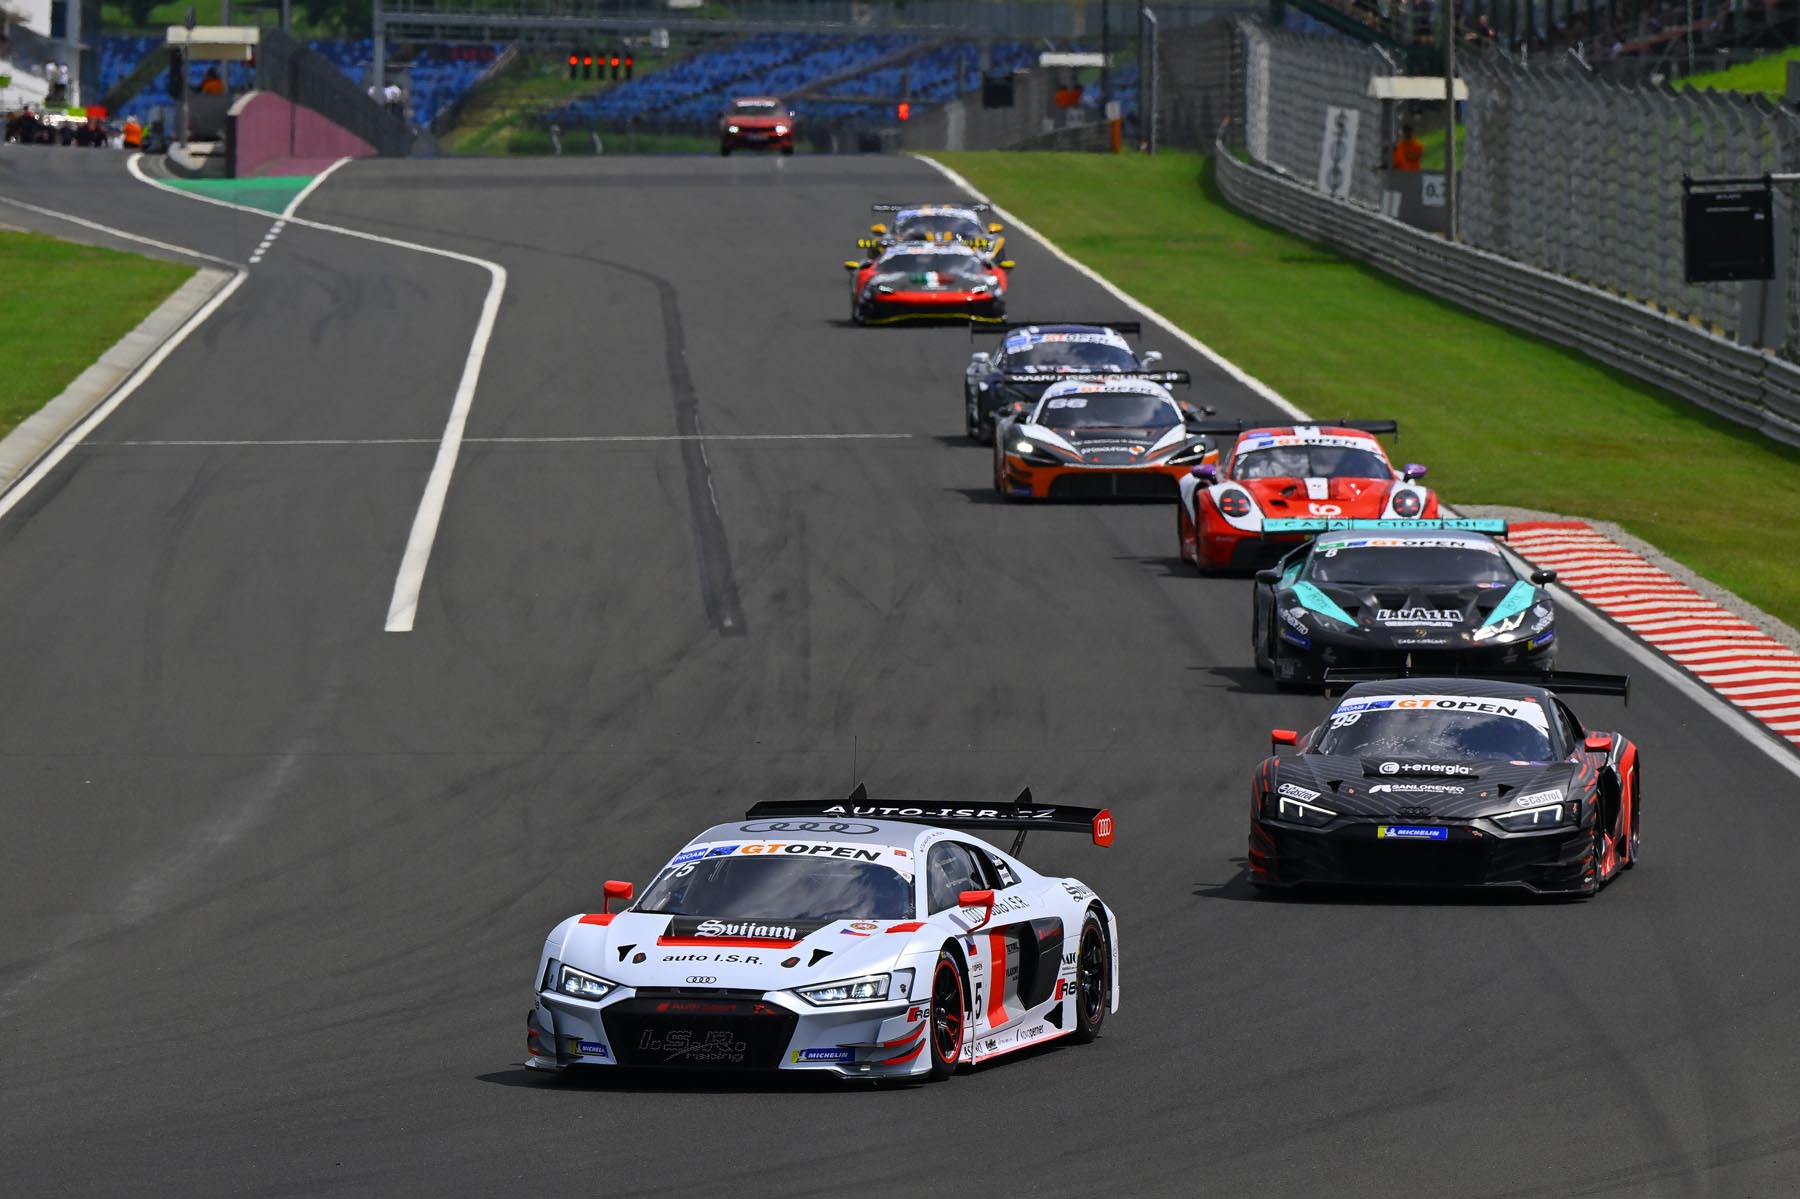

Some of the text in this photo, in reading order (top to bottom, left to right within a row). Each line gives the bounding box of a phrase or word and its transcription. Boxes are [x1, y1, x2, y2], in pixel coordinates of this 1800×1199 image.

[1397, 699, 1518, 716] GTOPEN
[1331, 713, 1362, 729] 99
[1285, 786, 1317, 800] Castrol
[1528, 791, 1561, 804] Castrol
[674, 844, 881, 864] PROAM GTOPEN
[694, 919, 797, 940] Svijany
[662, 953, 764, 966] auto I.S.R.
